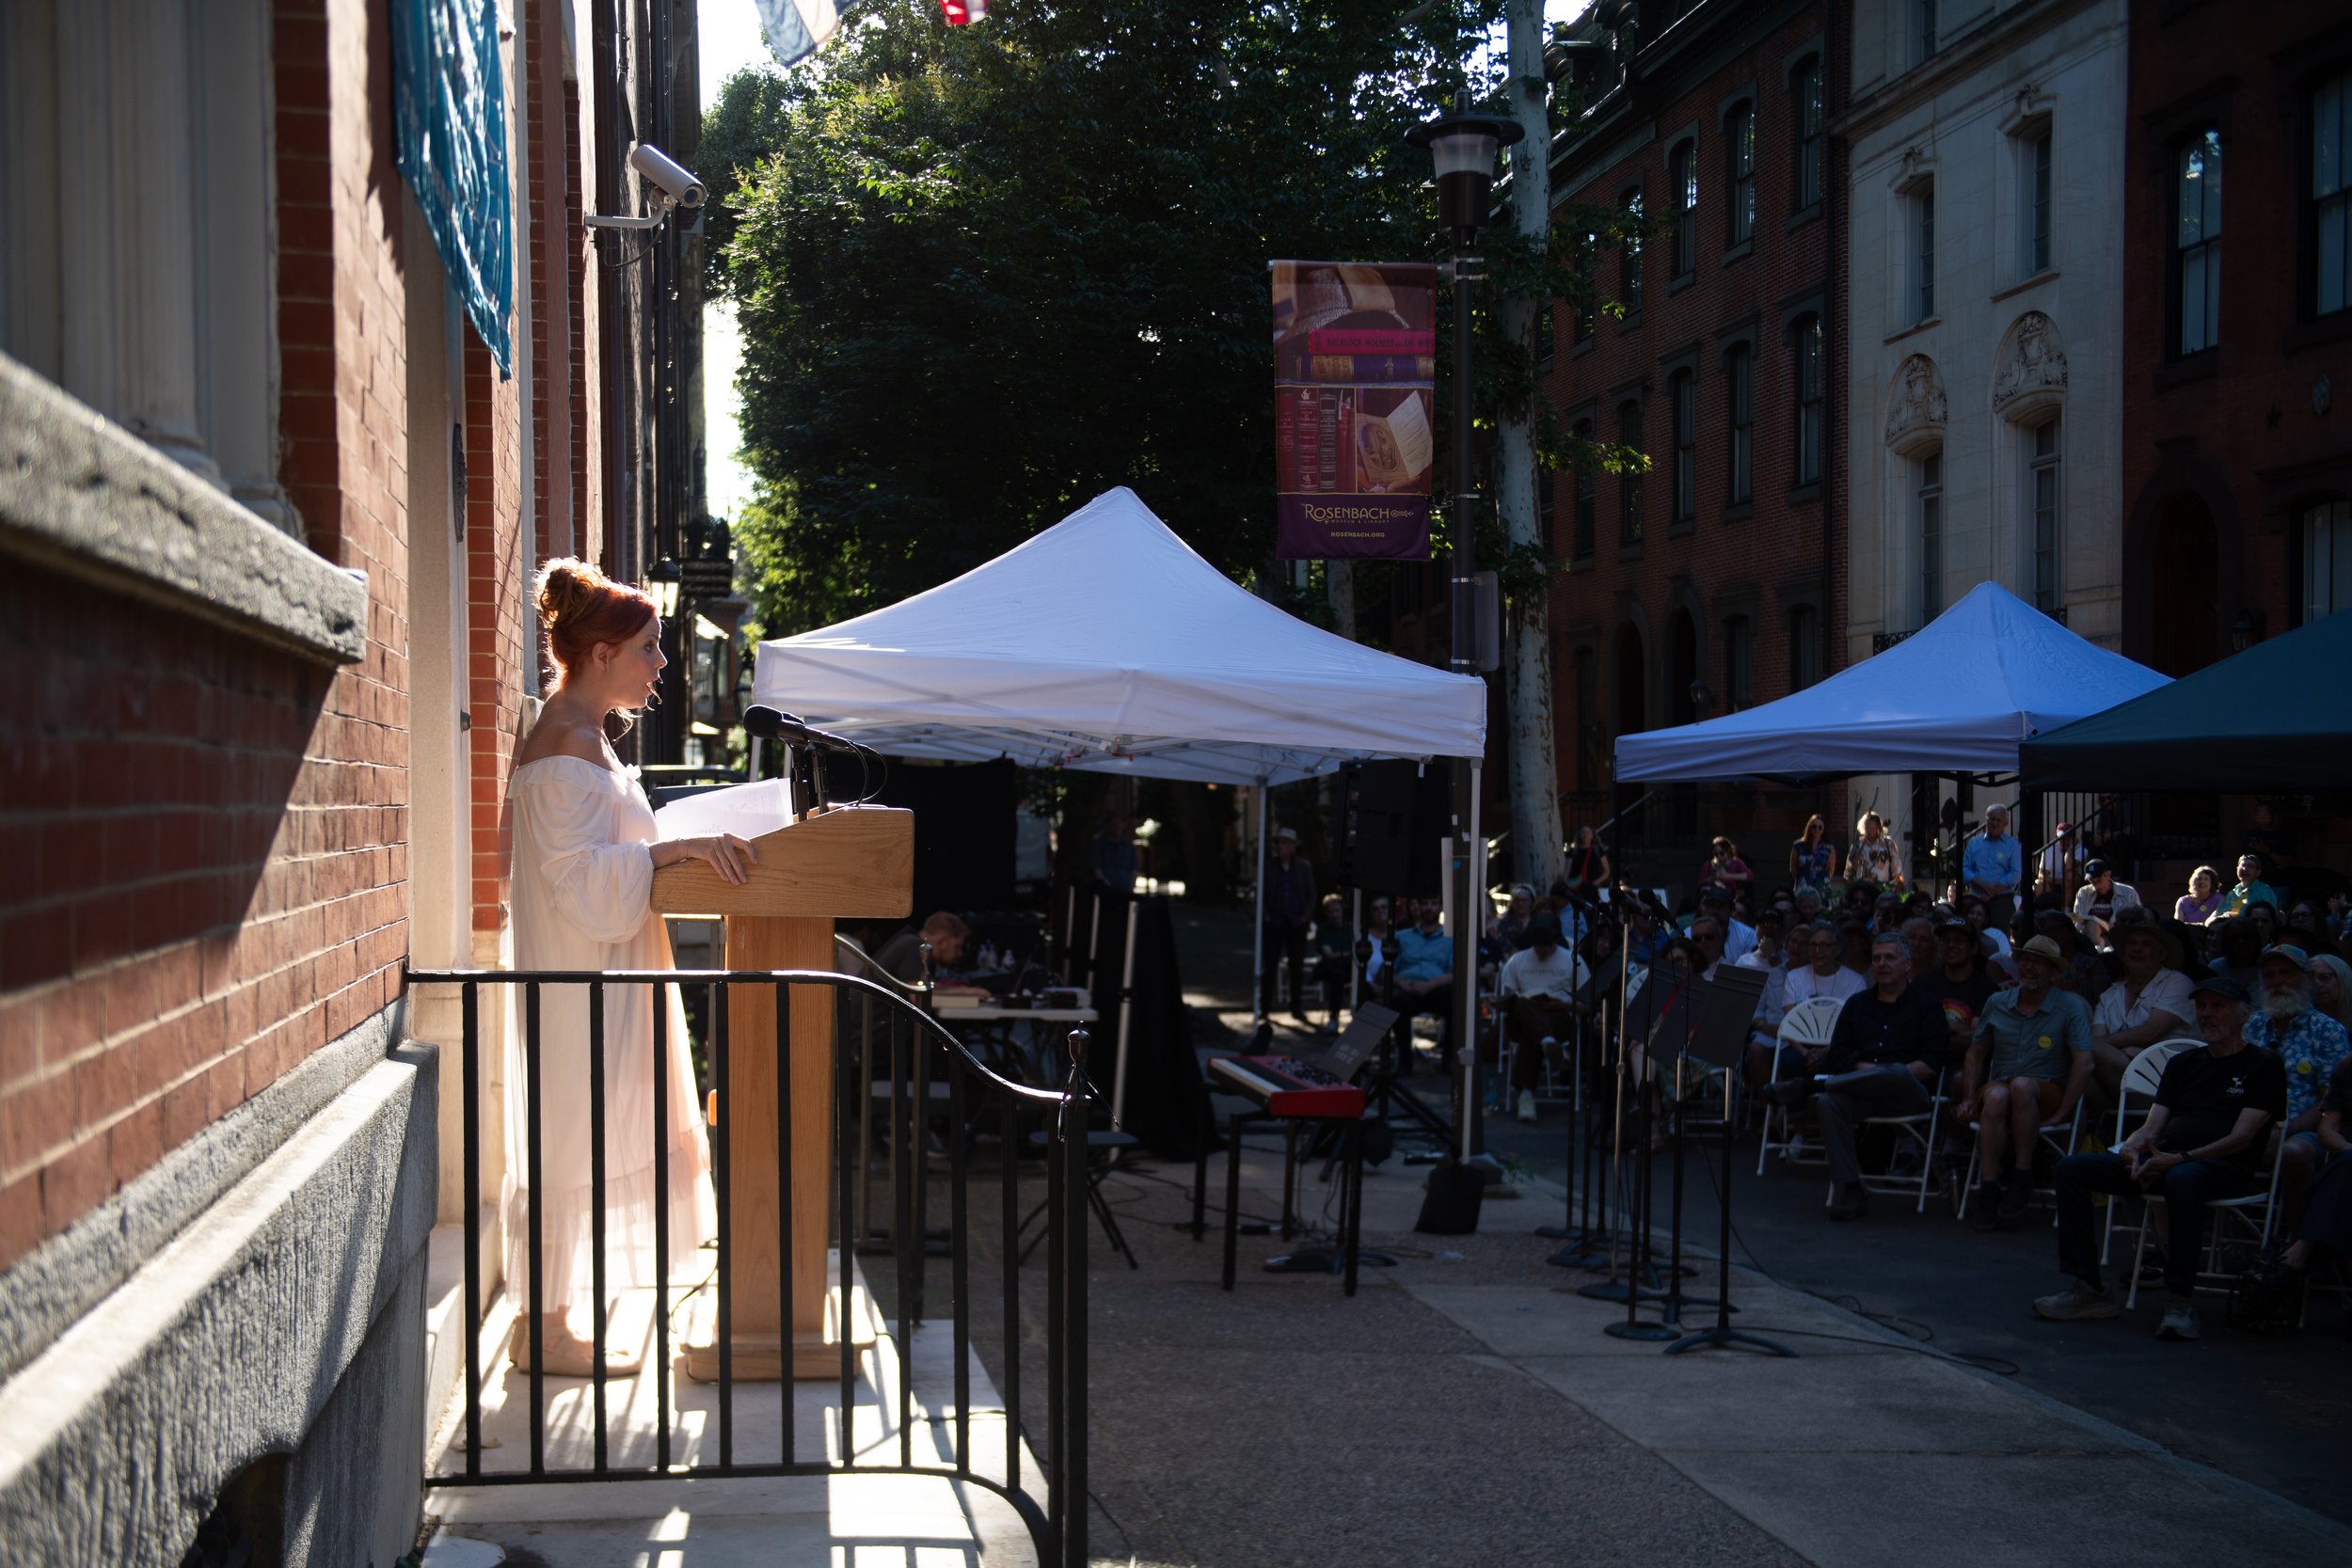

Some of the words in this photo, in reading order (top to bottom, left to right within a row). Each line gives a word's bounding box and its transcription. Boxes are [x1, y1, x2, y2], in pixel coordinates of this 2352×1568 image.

[1326, 338, 1362, 347] SHERLOCK
[1364, 338, 1394, 347] HOLMES
[1305, 503, 1390, 524] ROSENBACH
